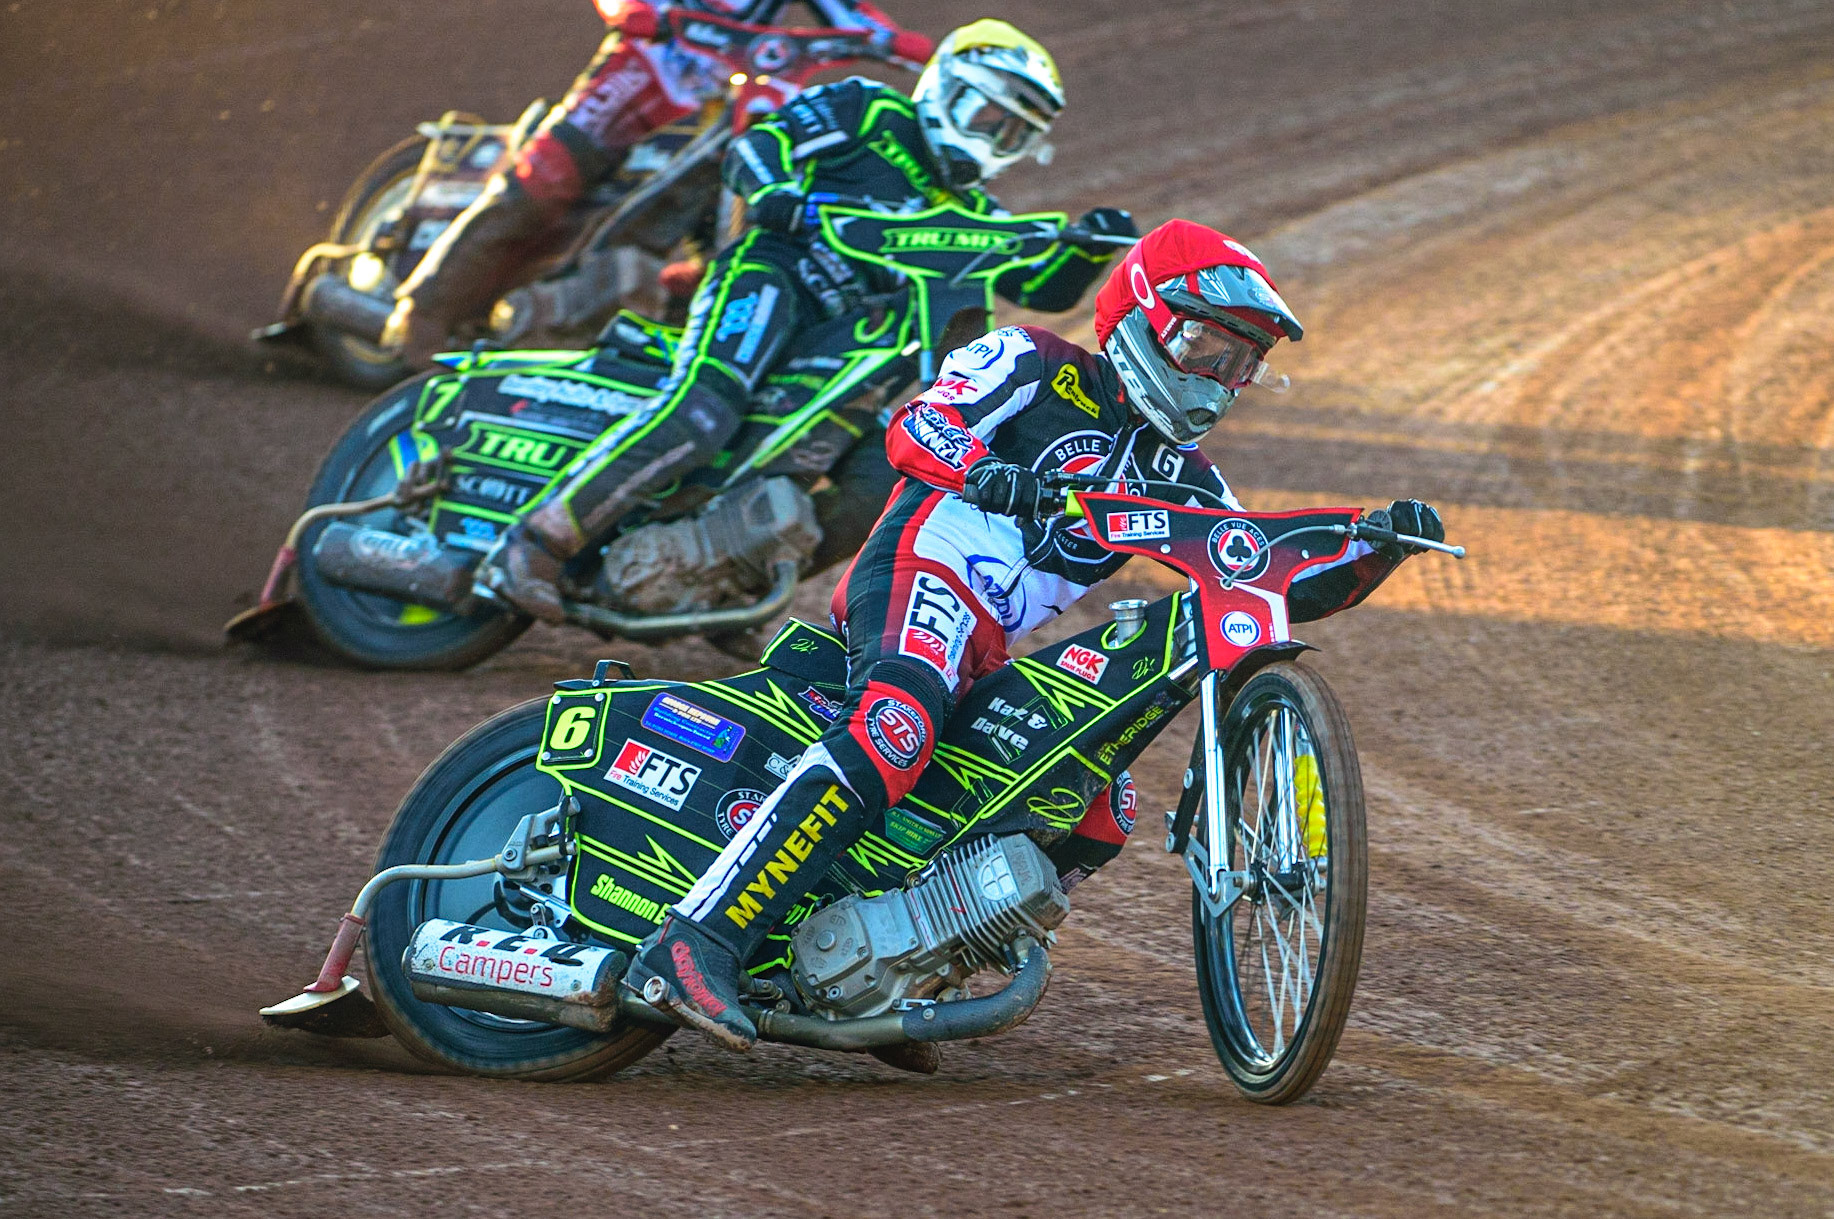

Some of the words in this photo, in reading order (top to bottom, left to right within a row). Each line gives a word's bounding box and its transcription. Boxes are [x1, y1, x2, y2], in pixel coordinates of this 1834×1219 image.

[479, 431, 568, 468] TRU
[1054, 439, 1101, 461] BELLE
[1157, 446, 1180, 480] G
[1127, 512, 1166, 531] FTS
[1211, 523, 1230, 543] BELLE
[1231, 521, 1248, 530] VUE
[1249, 528, 1266, 546] ACES
[908, 576, 961, 645] FTS
[1228, 623, 1253, 634] ATPI
[1060, 660, 1076, 672] SPARK
[1075, 667, 1096, 682] PLUGS
[1063, 646, 1104, 675] NGK
[549, 706, 596, 750] 6
[879, 708, 920, 752] STS
[988, 696, 1029, 721] Kaz
[1027, 713, 1048, 730] &
[970, 716, 1029, 751] Dave
[1099, 705, 1165, 766] ETHERIDGE
[874, 738, 909, 767] SERVICES
[609, 769, 623, 781] Fire
[623, 774, 650, 795] Training
[649, 787, 680, 807] Services
[638, 752, 698, 796] FTS
[724, 783, 850, 930] MYNEFIT
[590, 873, 660, 922] Shannon
[438, 946, 554, 987] Campers
